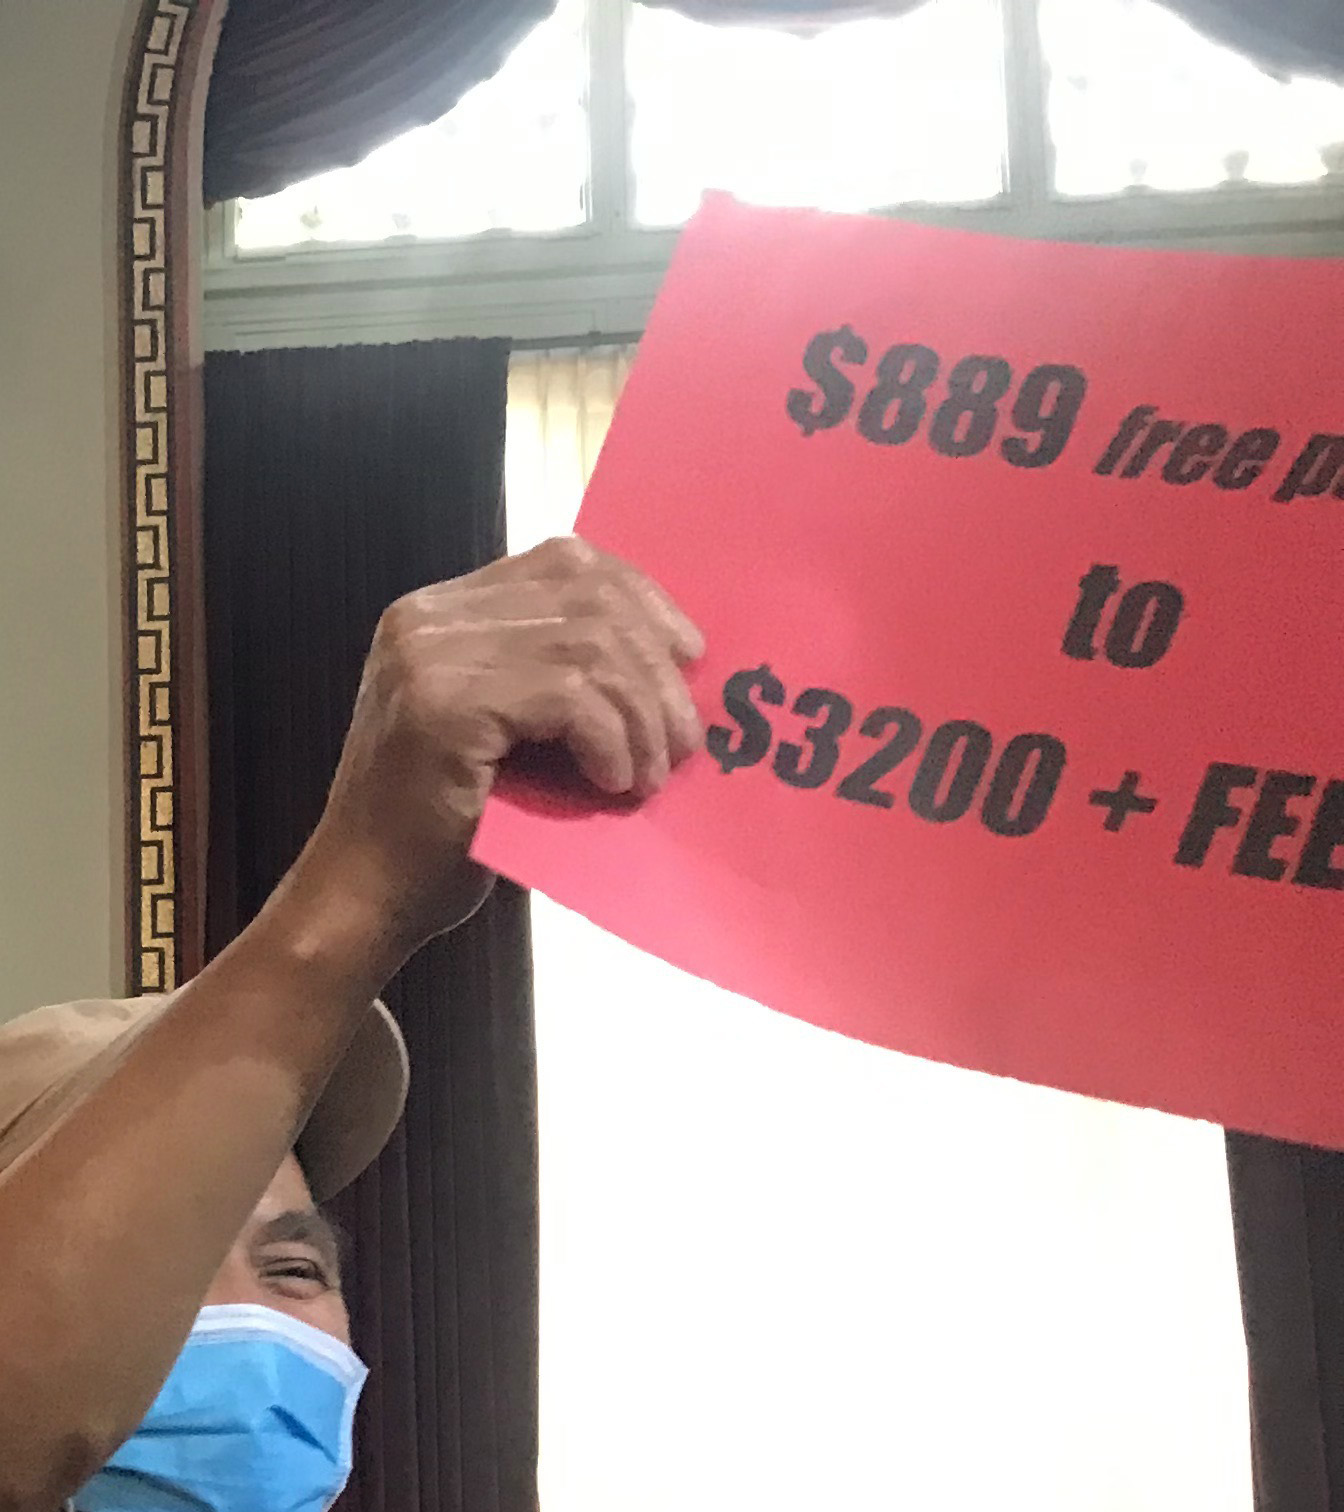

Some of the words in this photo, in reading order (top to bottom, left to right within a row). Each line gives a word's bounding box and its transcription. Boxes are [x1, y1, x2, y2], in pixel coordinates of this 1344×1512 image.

[785, 323, 1087, 469] $889
[1092, 404, 1281, 491] free
[1060, 563, 1185, 670] to
[706, 663, 1068, 838] $3200
[1088, 770, 1158, 831] +
